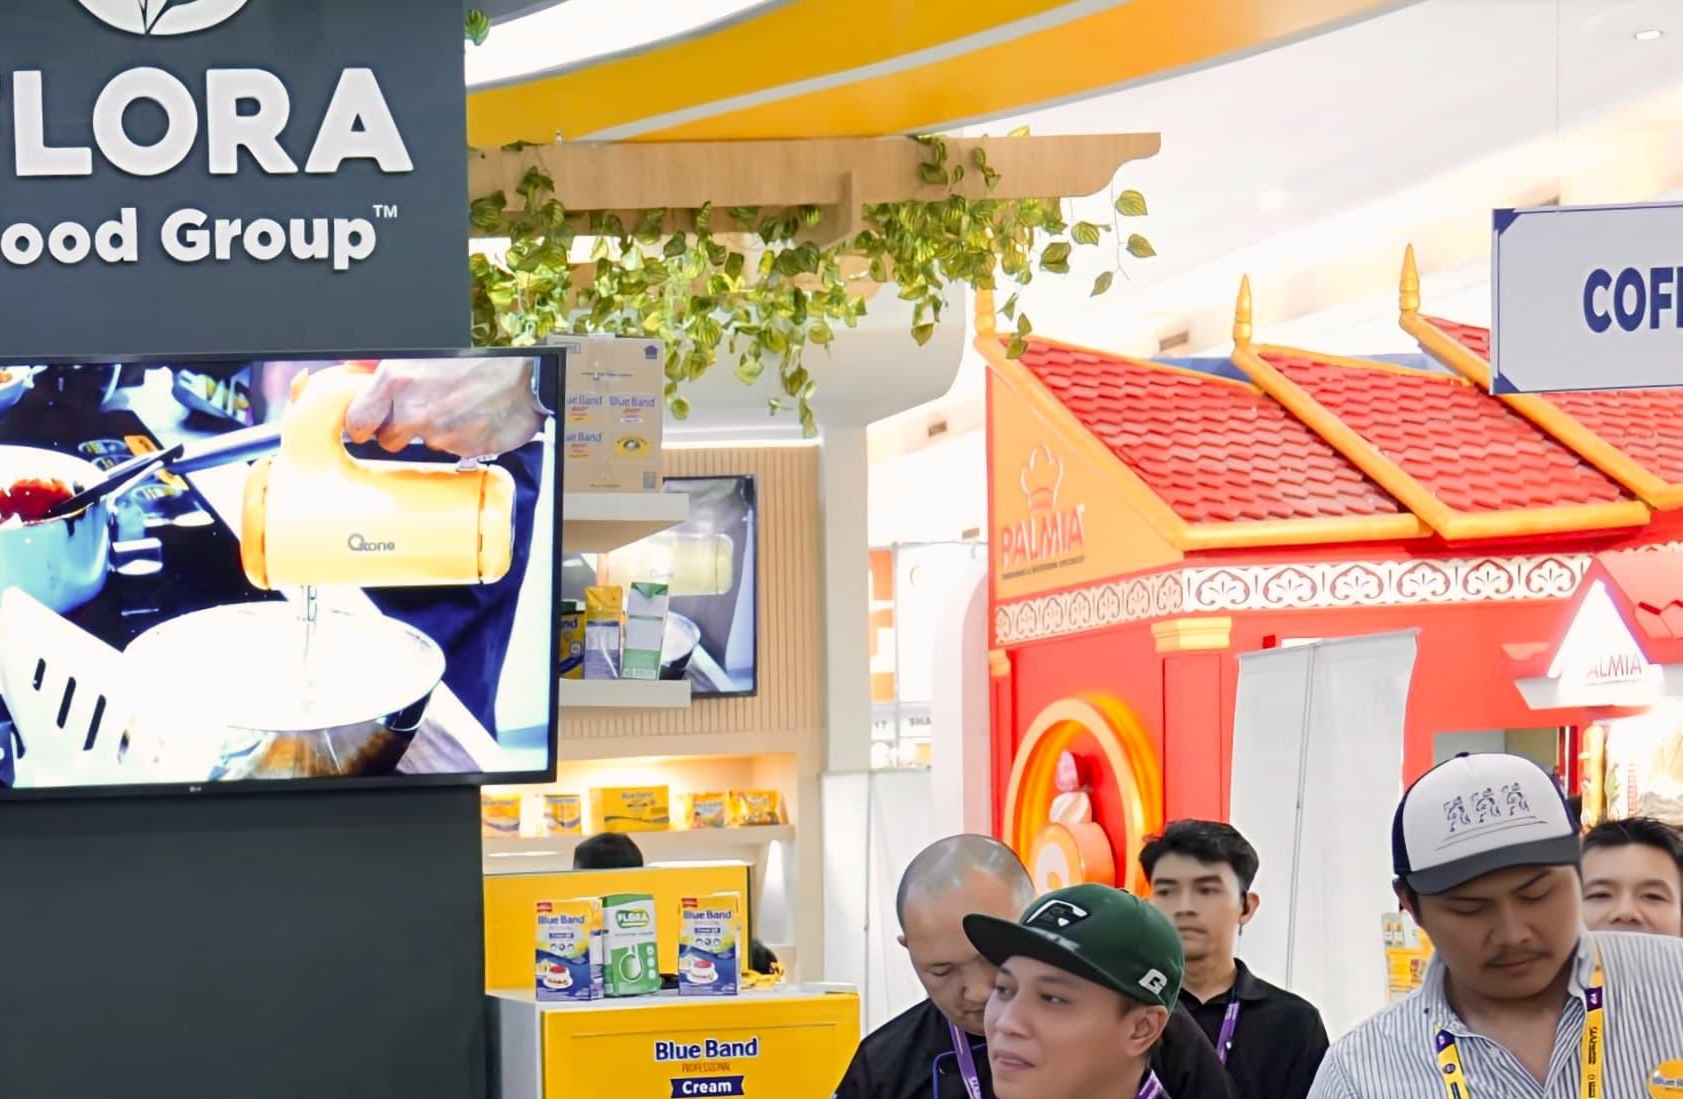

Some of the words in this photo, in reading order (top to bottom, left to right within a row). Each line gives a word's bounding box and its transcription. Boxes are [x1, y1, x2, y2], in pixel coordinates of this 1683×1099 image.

[161, 208, 377, 270] Group
[1002, 507, 1086, 569] PALMIA
[1586, 652, 1643, 679] ALMIA
[560, 914, 585, 925] Band
[706, 910, 732, 919] Band
[655, 1041, 701, 1060] Blue
[705, 1037, 758, 1058] Band
[681, 1080, 732, 1095] Cream
